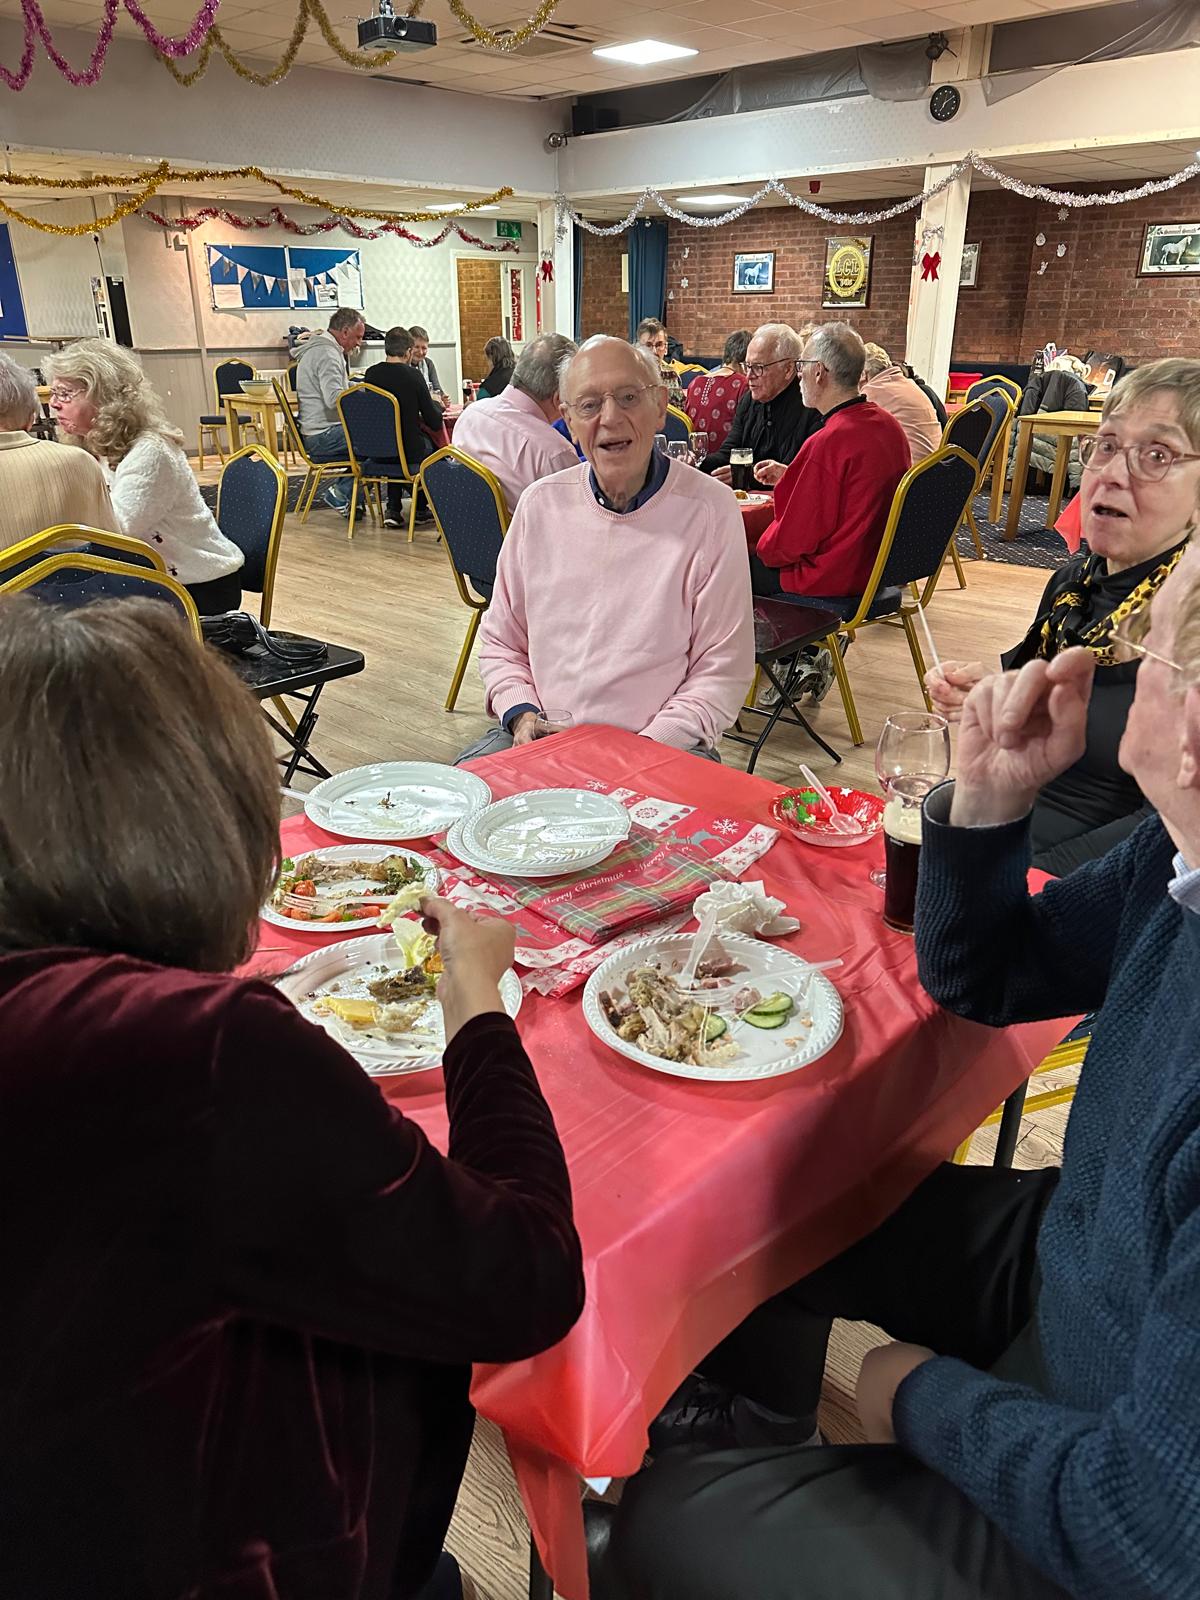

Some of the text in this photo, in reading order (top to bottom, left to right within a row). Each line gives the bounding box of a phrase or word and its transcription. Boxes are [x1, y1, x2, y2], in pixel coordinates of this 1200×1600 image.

[834, 258, 859, 276] LCL
[538, 891, 573, 911] Merry
[574, 871, 624, 892] Christmas
